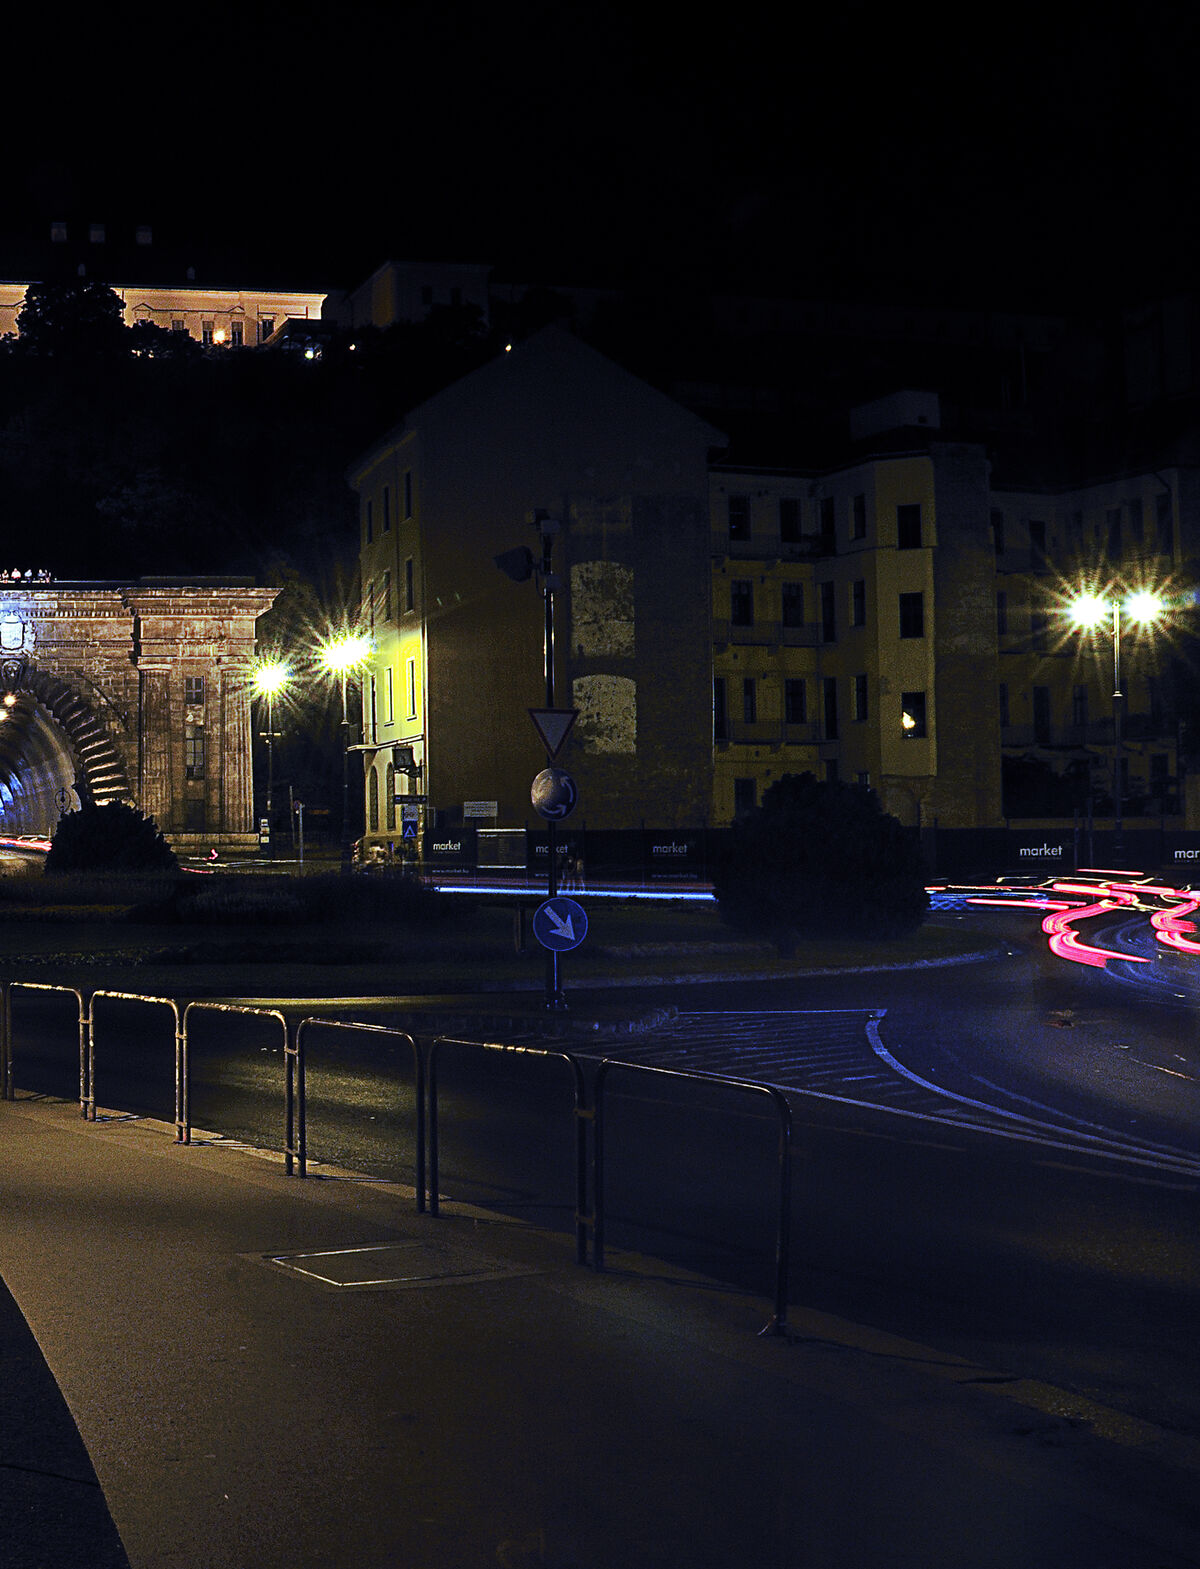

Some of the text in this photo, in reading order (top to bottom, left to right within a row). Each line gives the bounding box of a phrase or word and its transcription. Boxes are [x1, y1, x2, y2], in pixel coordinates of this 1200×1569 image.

[432, 840, 461, 851] market
[652, 841, 688, 853] market
[1019, 843, 1063, 856] market
